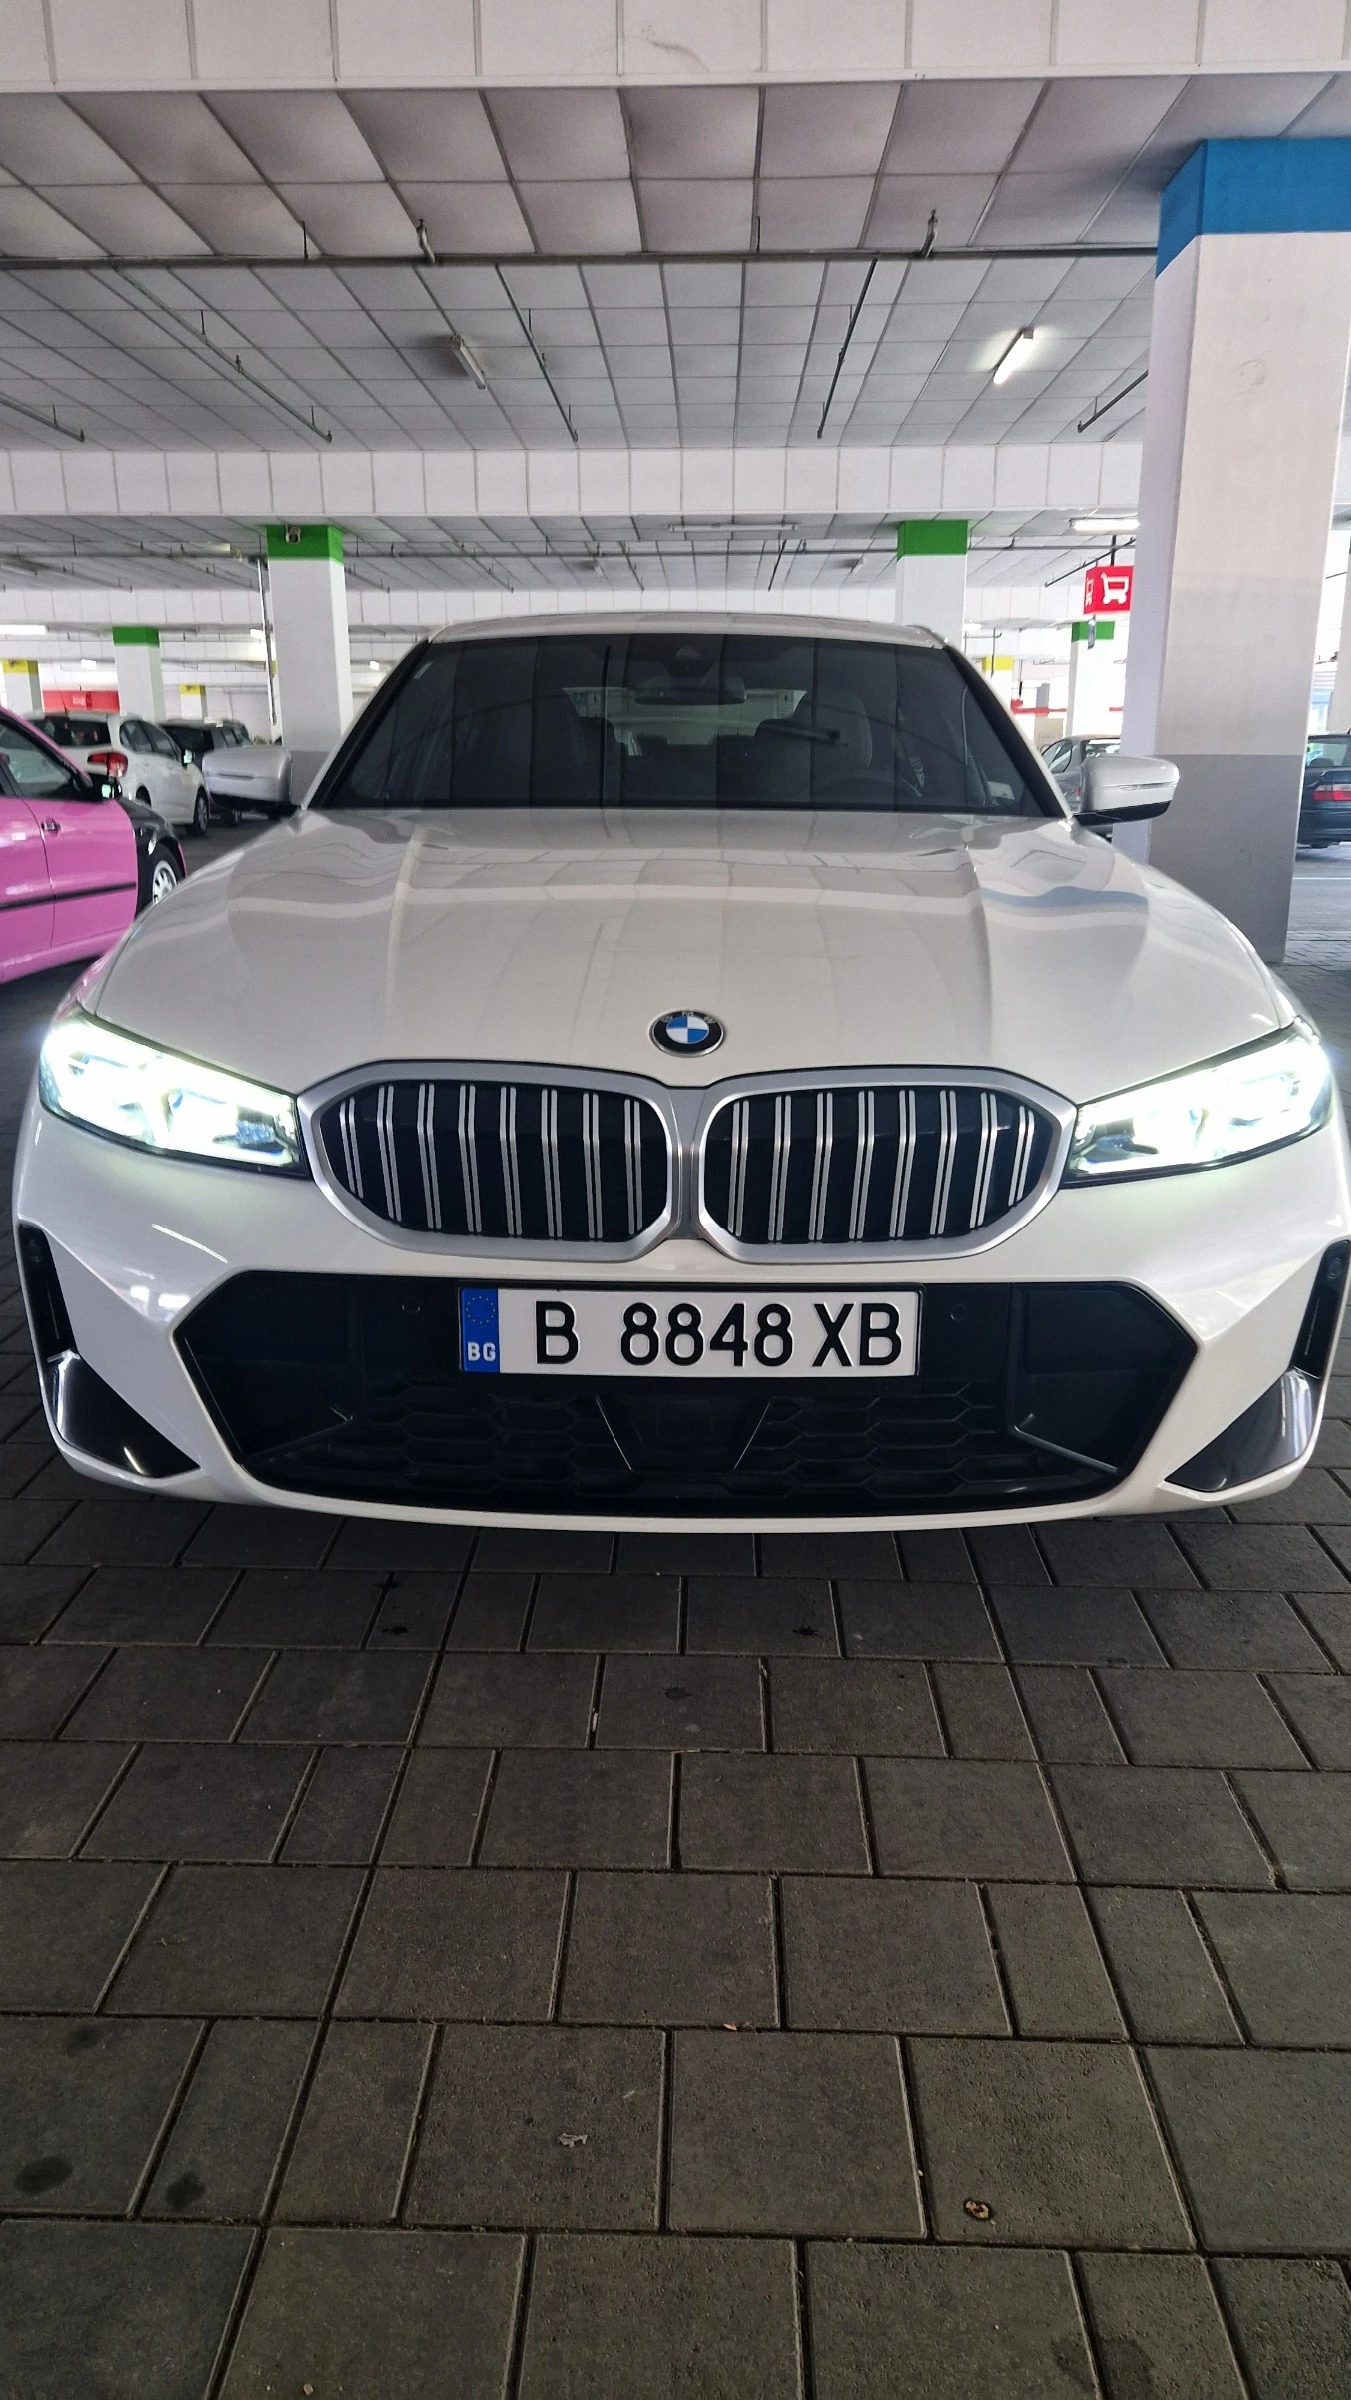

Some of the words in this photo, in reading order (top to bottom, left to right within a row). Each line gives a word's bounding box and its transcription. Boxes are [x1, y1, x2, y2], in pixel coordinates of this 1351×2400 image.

[467, 1341, 496, 1362] BG
[535, 1300, 579, 1365] B
[620, 1302, 794, 1367] 8848
[811, 1302, 902, 1367] XB
